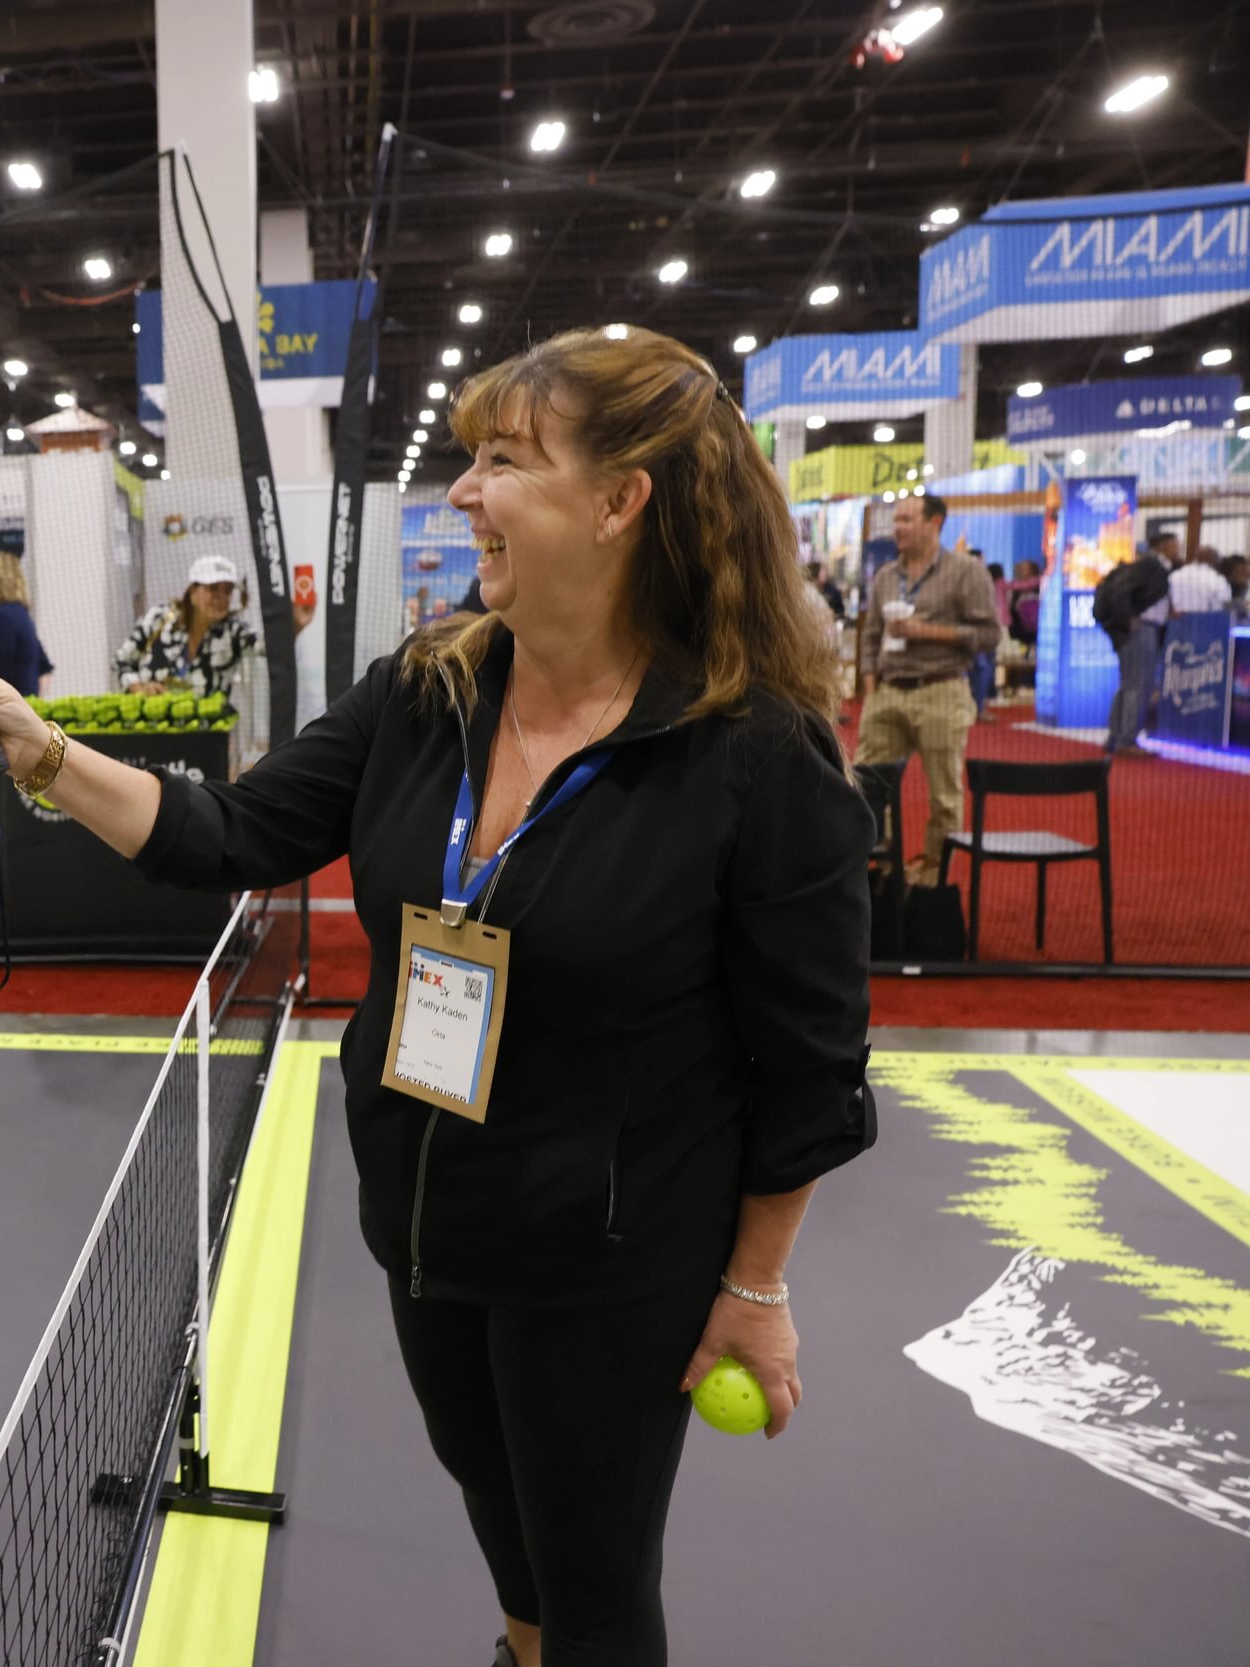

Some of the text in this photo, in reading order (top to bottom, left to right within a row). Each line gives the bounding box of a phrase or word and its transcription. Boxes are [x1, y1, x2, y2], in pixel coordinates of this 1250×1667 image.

[1030, 206, 1250, 271] MIAMI
[275, 332, 319, 355] BAY
[804, 344, 941, 382] MIAMI
[417, 996, 469, 1021] Kathy Kaden
